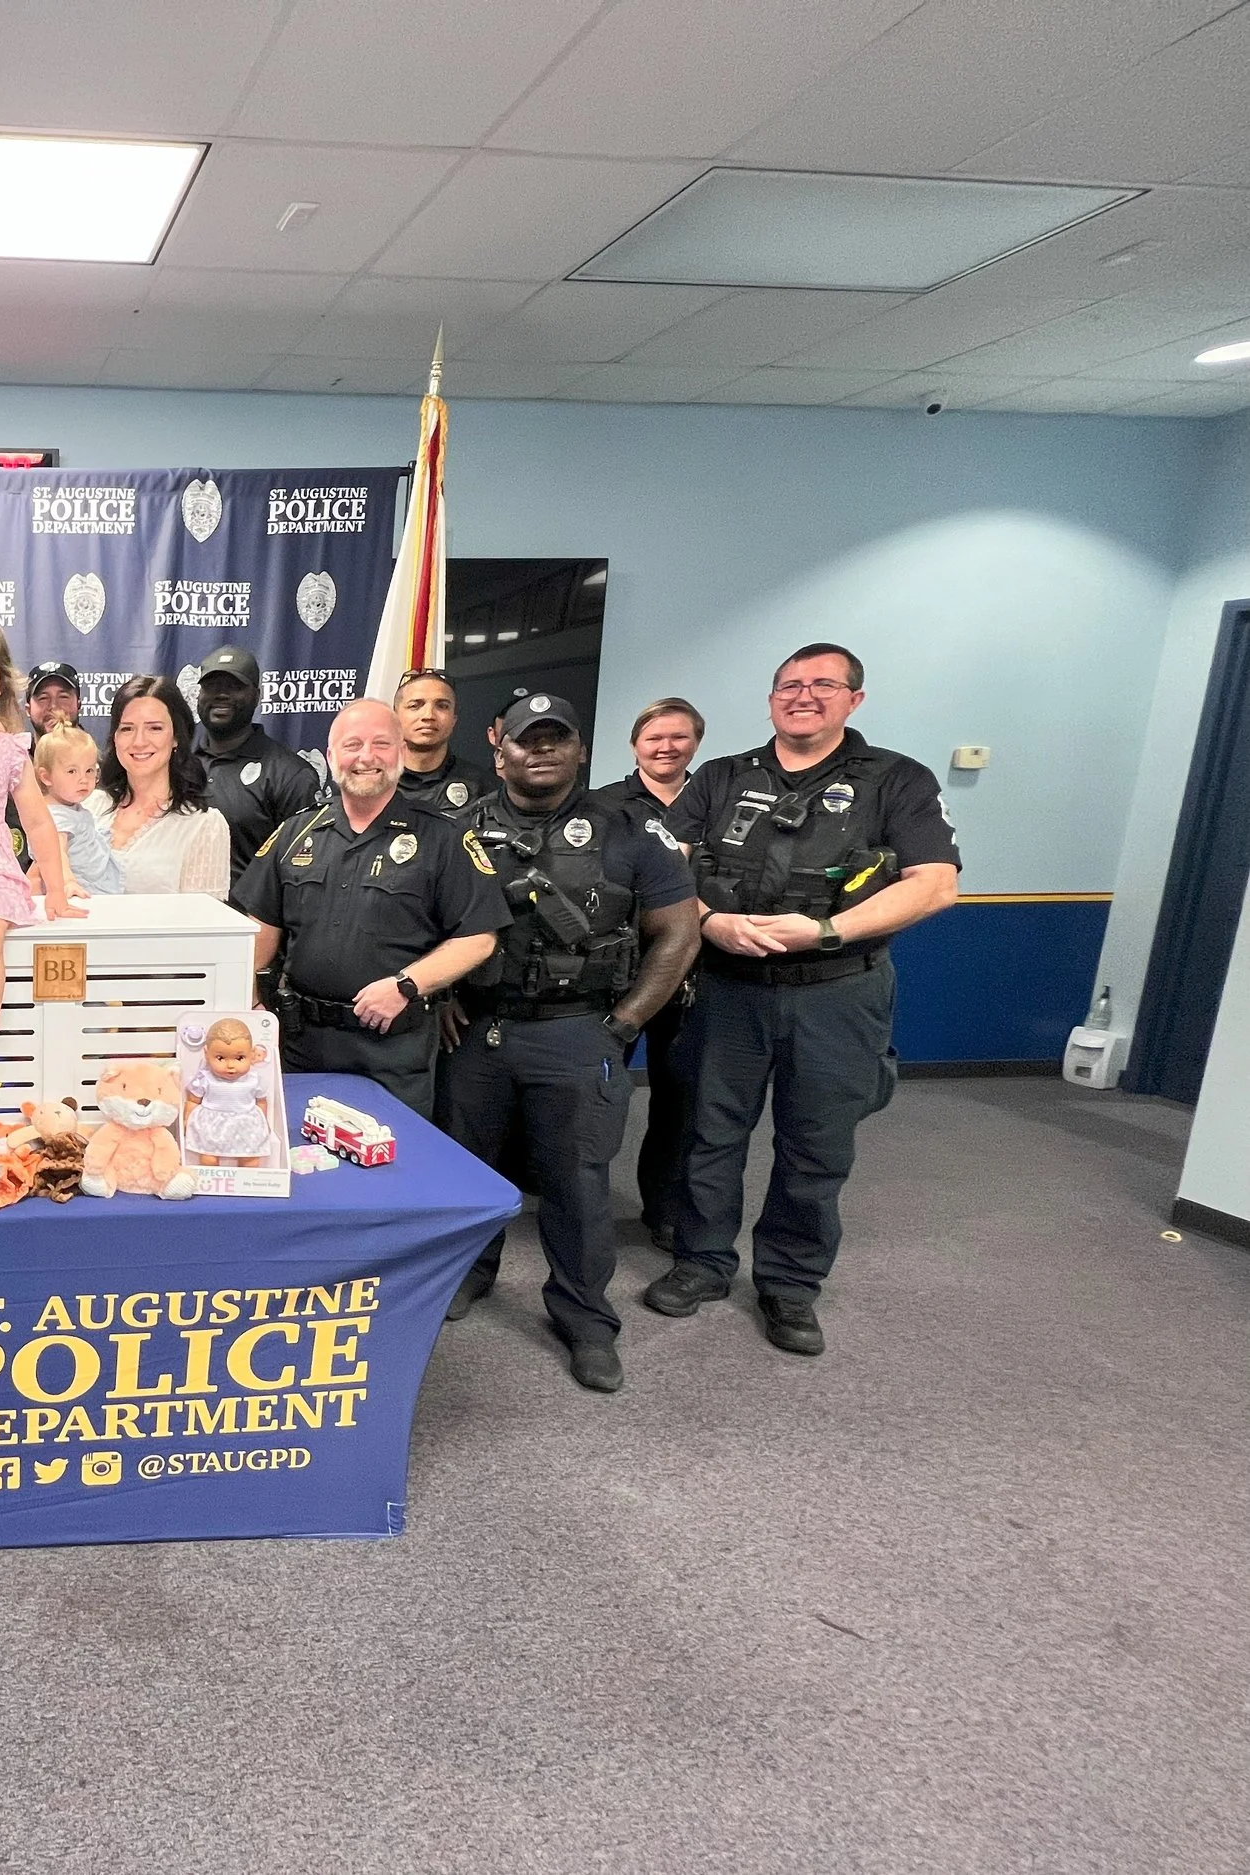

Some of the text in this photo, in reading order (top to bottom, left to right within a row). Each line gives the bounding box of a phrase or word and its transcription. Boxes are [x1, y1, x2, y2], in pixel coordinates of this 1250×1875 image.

[33, 487, 136, 500] ST. AUGUSTINE
[269, 487, 368, 500] ST. AUGUSTINE
[32, 499, 136, 521] POLICE
[267, 499, 366, 521] POLICE
[32, 521, 135, 534] DEPARTMENT
[267, 521, 365, 534] DEPARTMENT
[154, 580, 251, 593] ST. AUGUSTINE
[154, 592, 250, 614] POLICE
[154, 613, 250, 627] DEPARTMENT
[262, 669, 356, 682] ST. AUGUSTINE
[261, 680, 355, 702] POLICE
[44, 959, 76, 981] BB
[33, 1276, 381, 1332] AUGUSTINE
[137, 1447, 311, 1480] @STAUGPD
